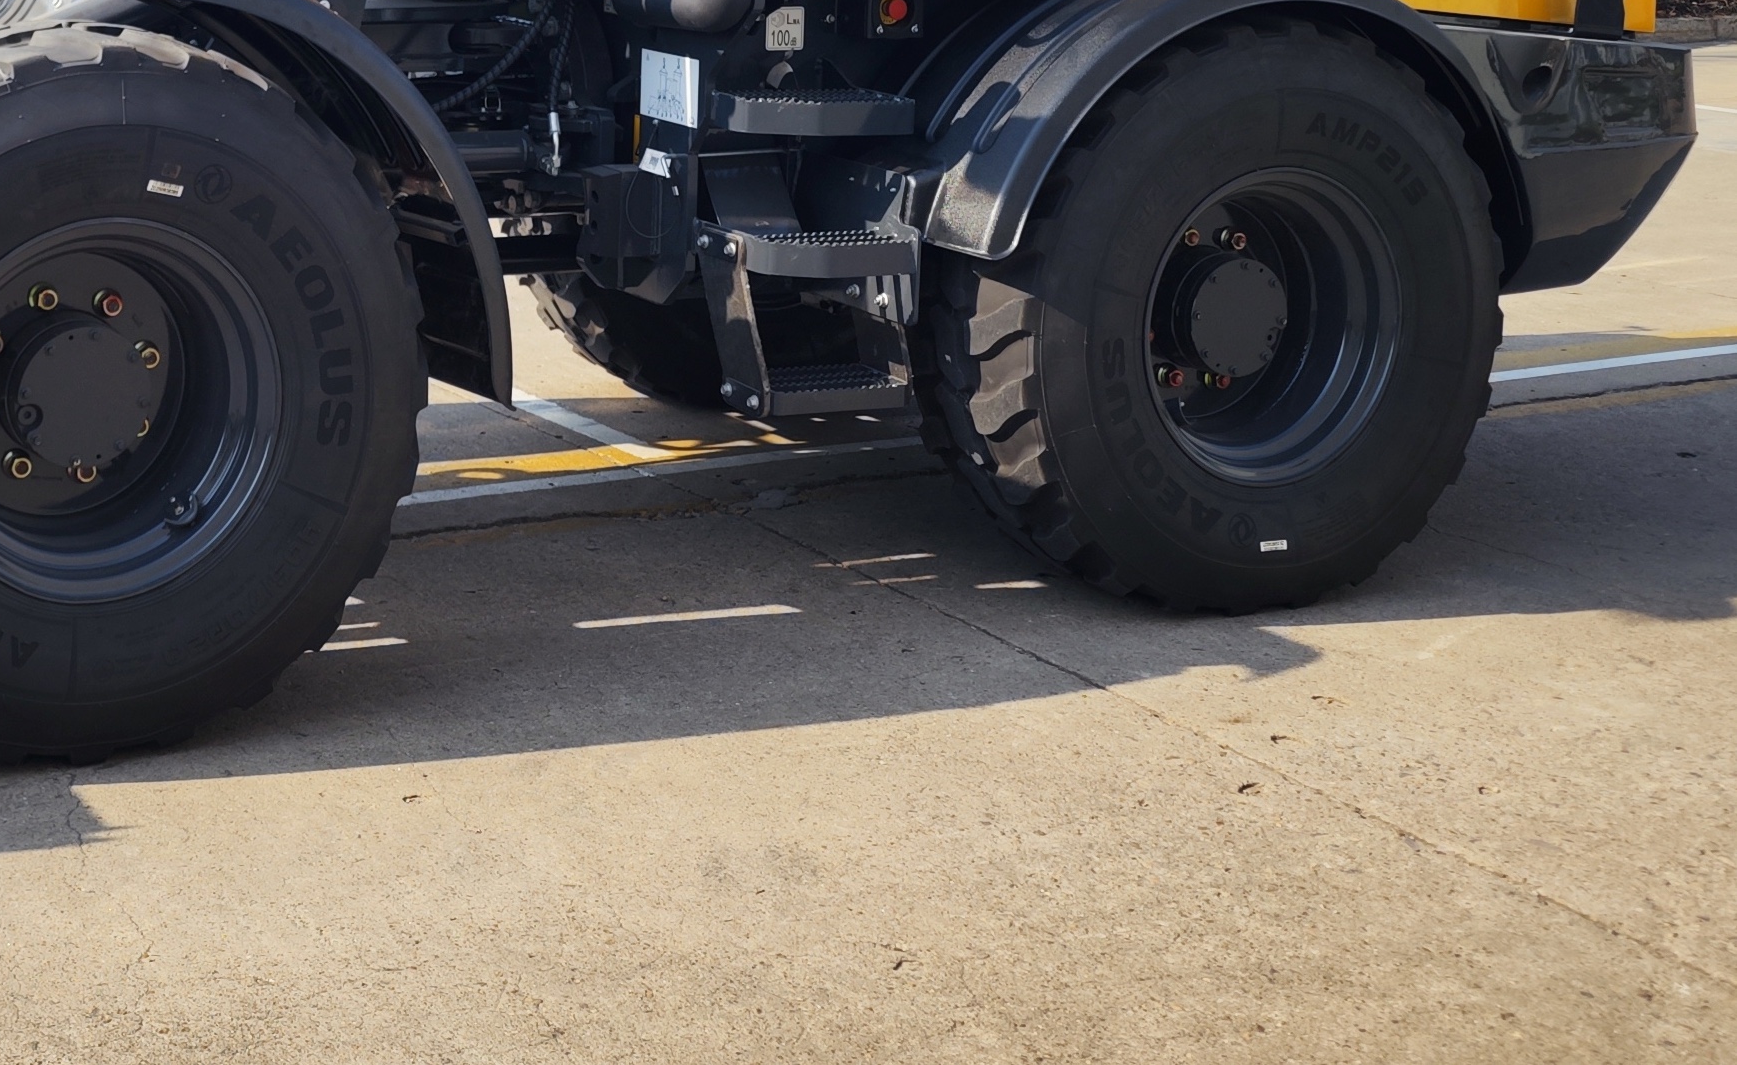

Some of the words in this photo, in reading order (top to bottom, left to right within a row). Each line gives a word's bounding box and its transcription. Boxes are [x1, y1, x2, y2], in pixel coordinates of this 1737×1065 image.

[1306, 112, 1429, 207] AMP215
[229, 193, 357, 448] AEOLUS
[1100, 337, 1224, 535] AEOLUS
